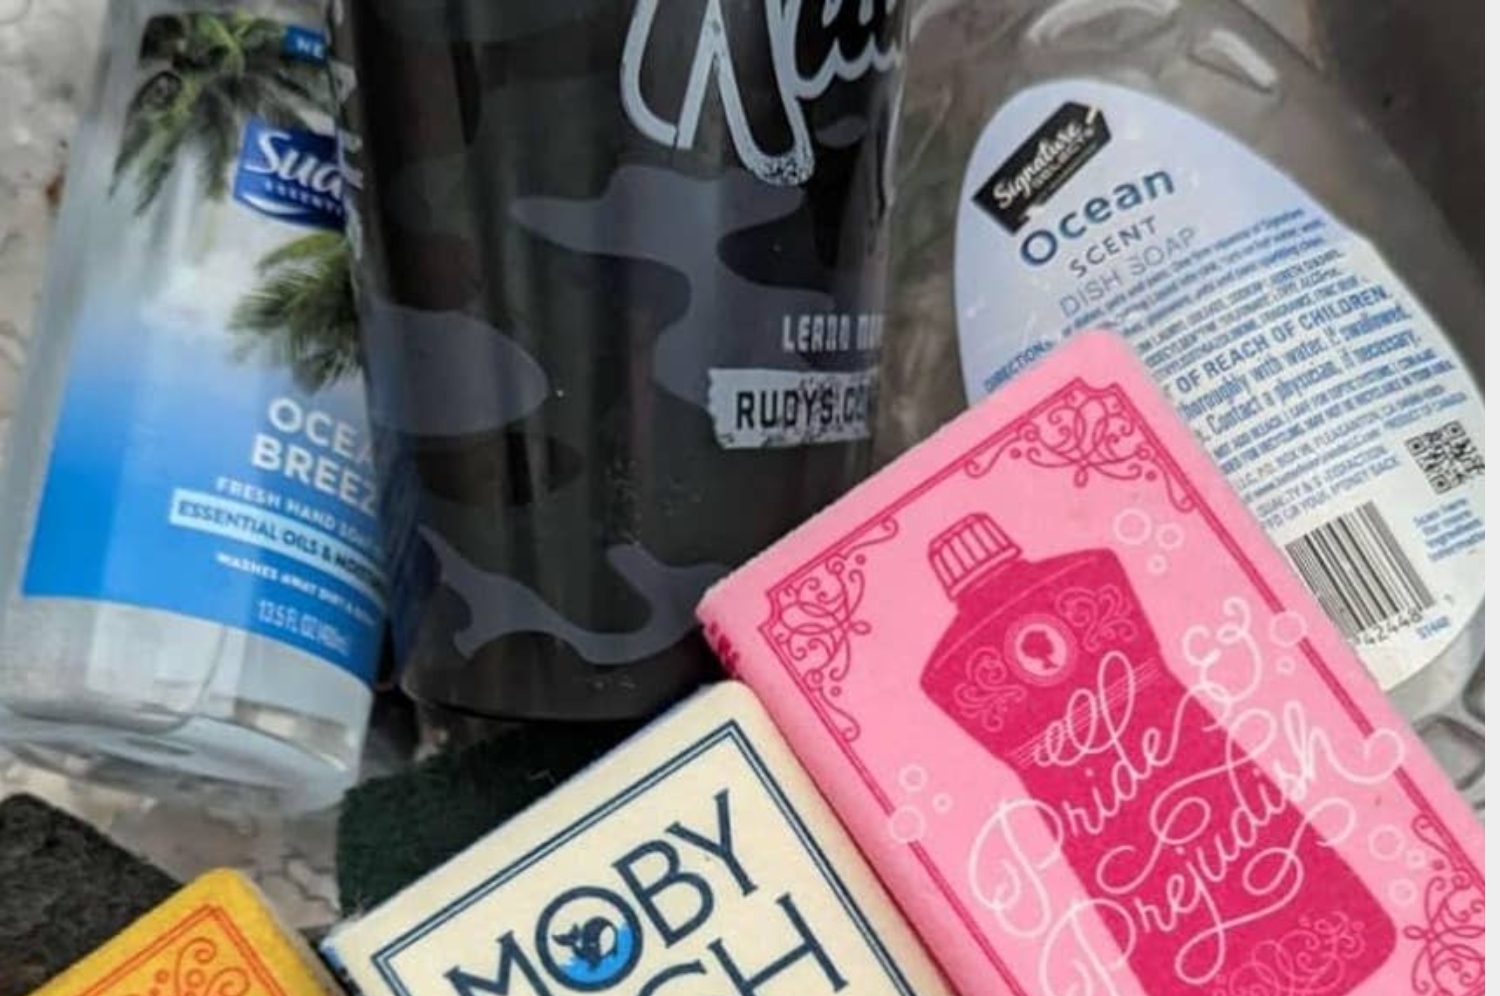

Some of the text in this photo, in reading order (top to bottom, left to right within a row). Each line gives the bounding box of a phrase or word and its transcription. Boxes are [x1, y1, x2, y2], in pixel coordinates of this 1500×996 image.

[993, 117, 1082, 208] Signature
[1019, 167, 1175, 267] Ocean
[1068, 216, 1158, 278] SCENT
[1059, 267, 1123, 316] DISH
[1128, 228, 1198, 274] SOAP
[1176, 369, 1200, 393] OF
[1203, 333, 1269, 378] REACH
[1272, 321, 1295, 343] OF
[178, 499, 278, 542] ESSENTIAL
[968, 650, 1228, 938] Pride
